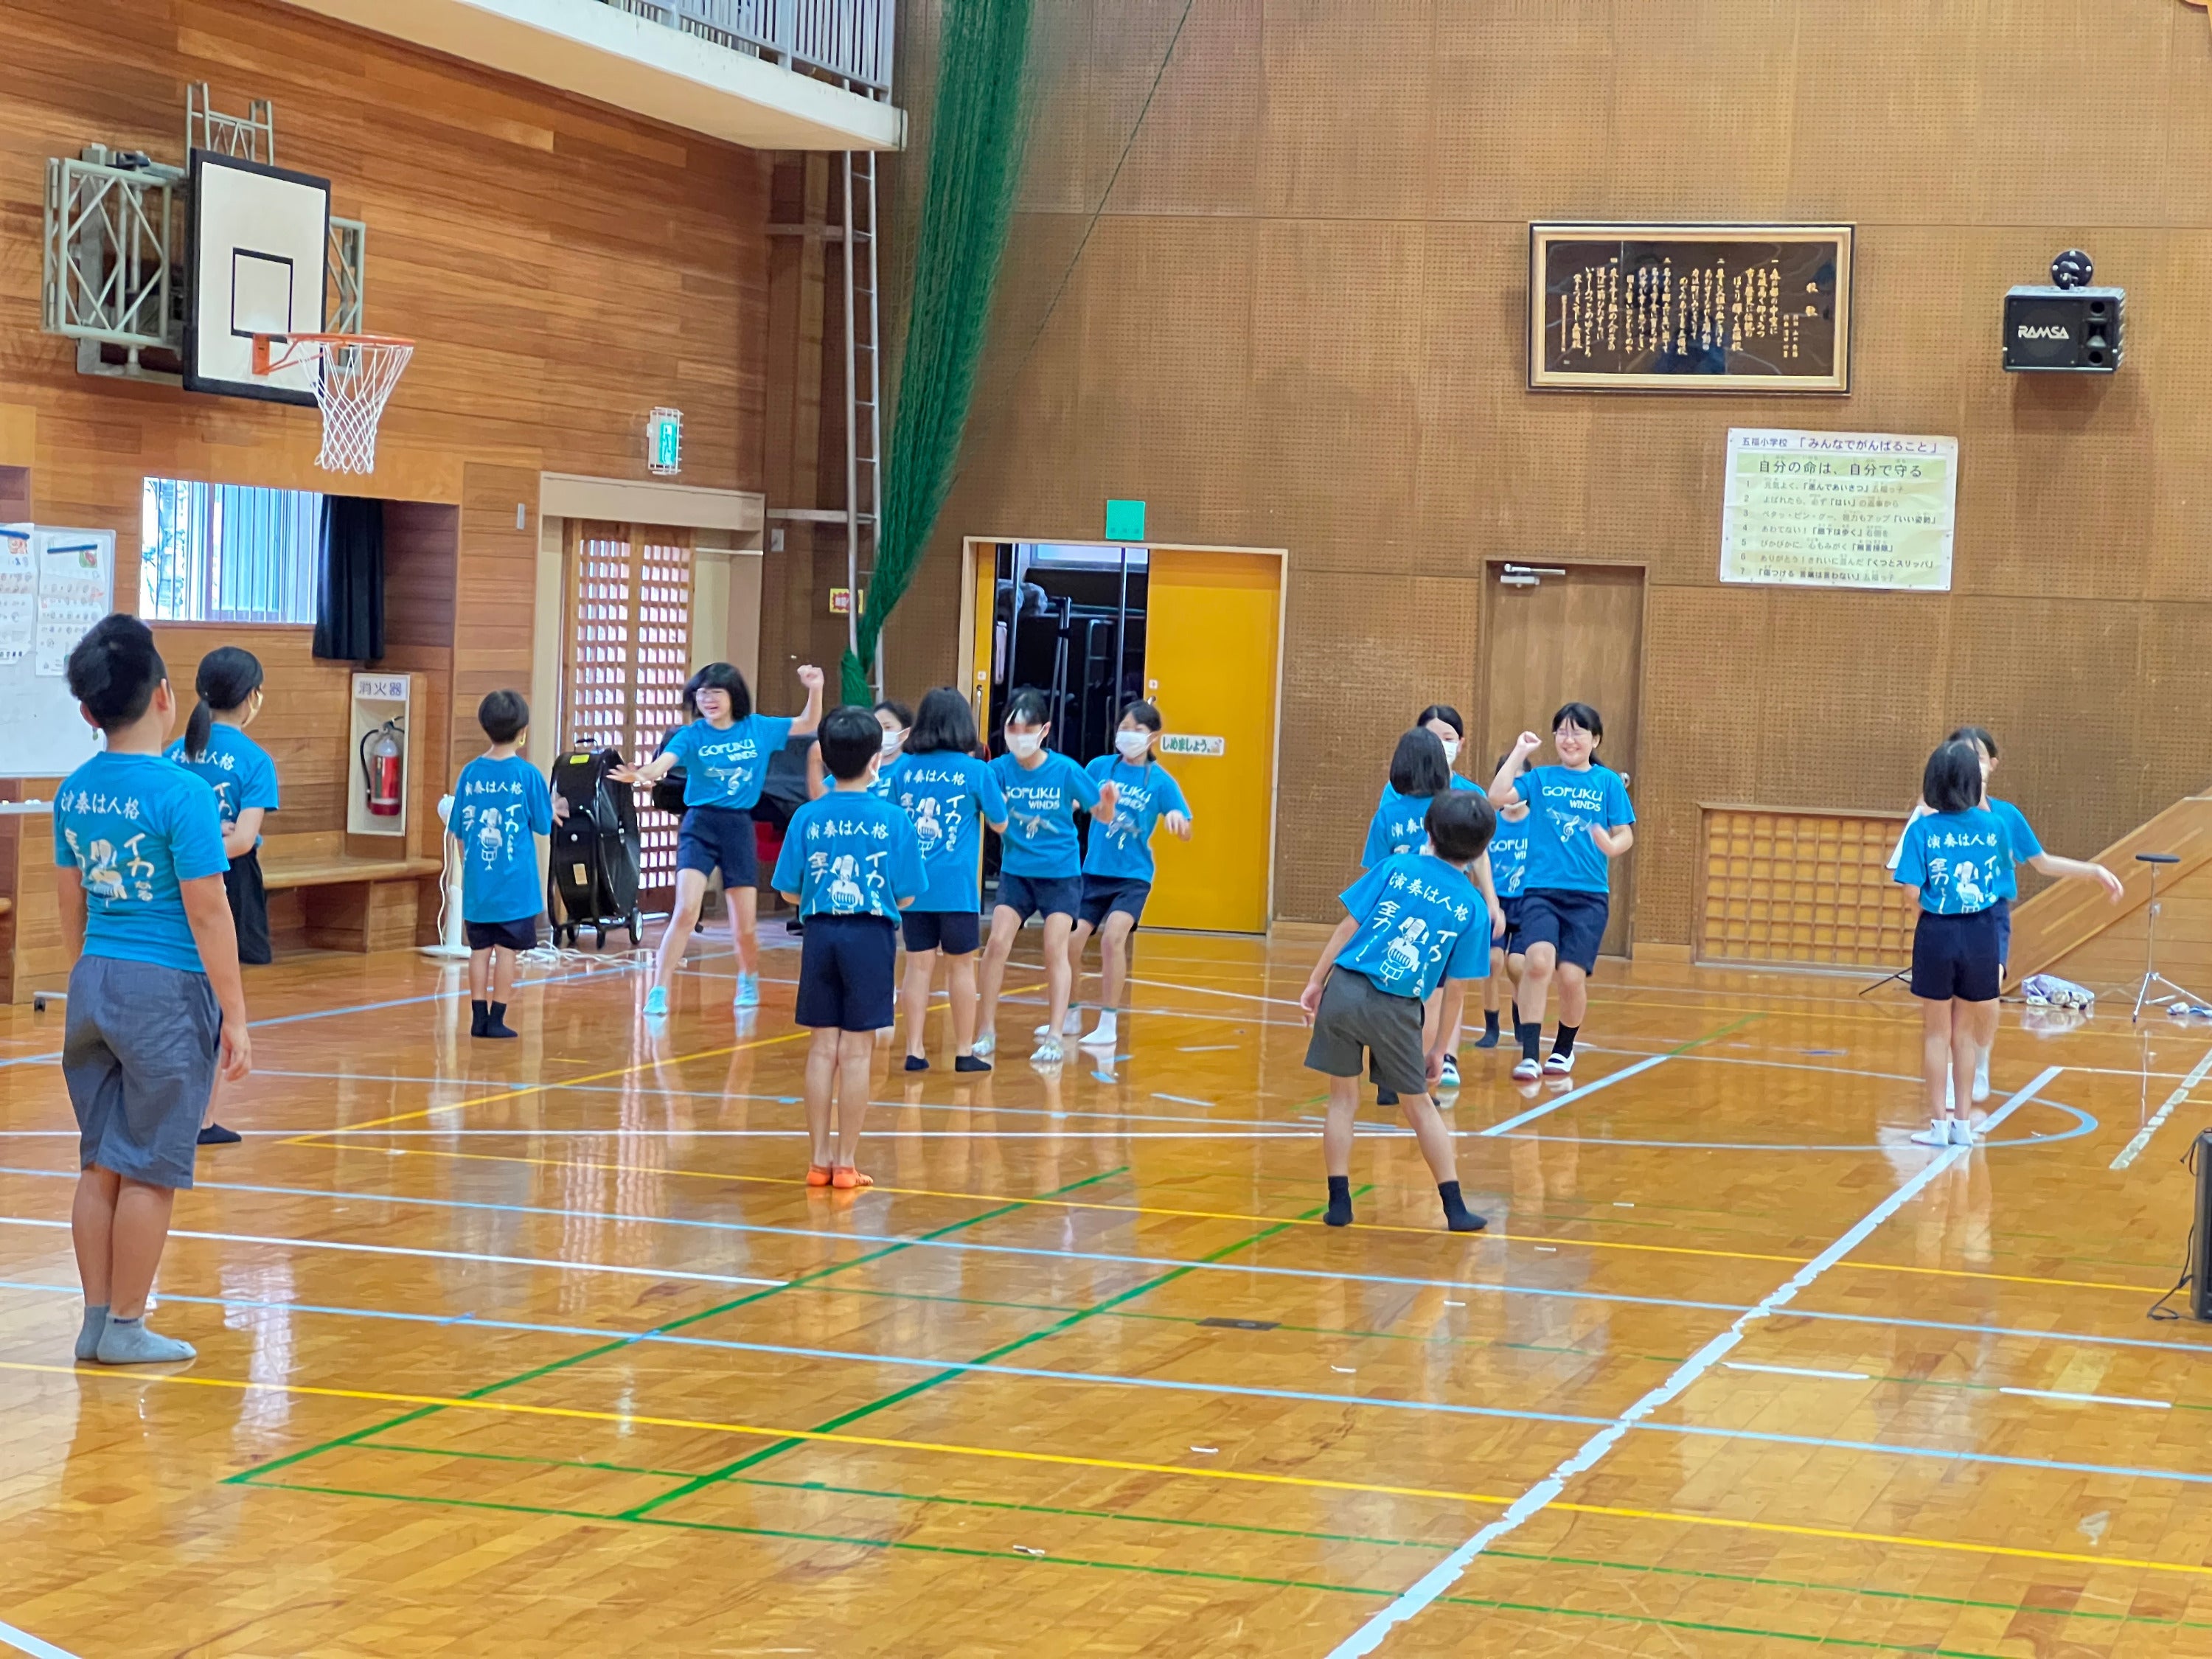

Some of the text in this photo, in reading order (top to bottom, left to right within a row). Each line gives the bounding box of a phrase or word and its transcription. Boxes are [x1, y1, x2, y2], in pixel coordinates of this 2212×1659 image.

[2017, 325, 2070, 339] RAMSA
[1742, 437, 1938, 453] 五福小学校 「みんなでがんばること」
[1759, 460, 1922, 478] 自分の命は、 自分で守る
[358, 681, 402, 696] 消火器
[698, 739, 756, 757] GOFUKU
[727, 750, 758, 762] WINDS
[1542, 785, 1604, 802] GOFUKU
[1028, 800, 1060, 810] WINDS
[1569, 799, 1602, 812] WINDS
[807, 819, 888, 841] 演奏は人格
[1927, 832, 1997, 849] 演奏は人格
[1388, 872, 1470, 922] 演奏は人格
